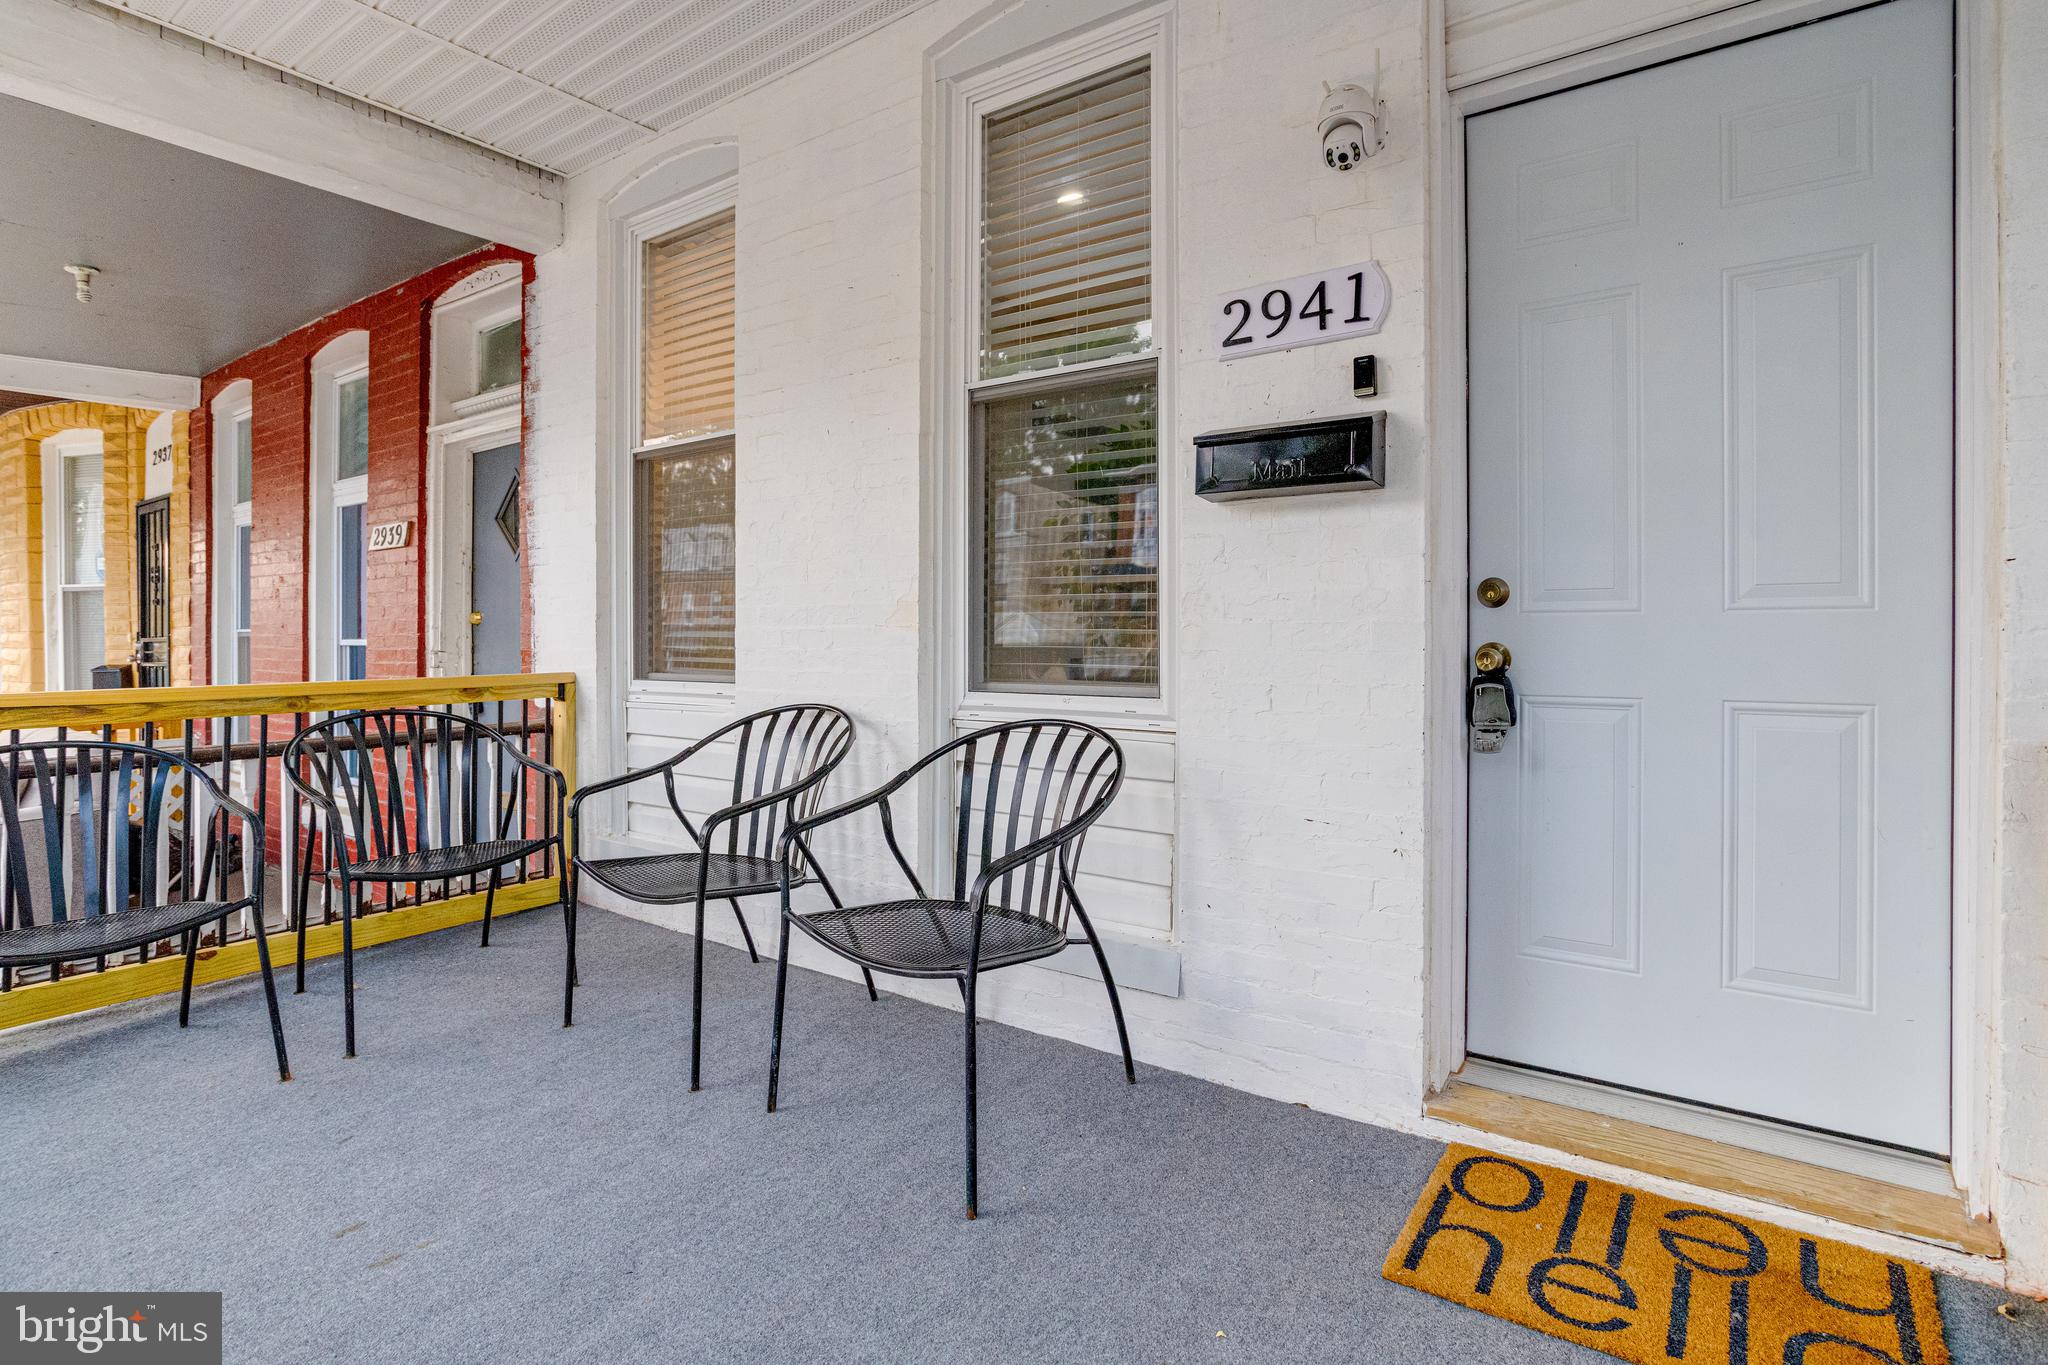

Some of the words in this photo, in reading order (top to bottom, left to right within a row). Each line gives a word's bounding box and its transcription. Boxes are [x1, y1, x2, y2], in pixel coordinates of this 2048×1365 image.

[1222, 272, 1370, 347] 2941
[152, 444, 172, 466] 2937
[1250, 457, 1306, 481] Mail
[373, 524, 403, 547] 2939
